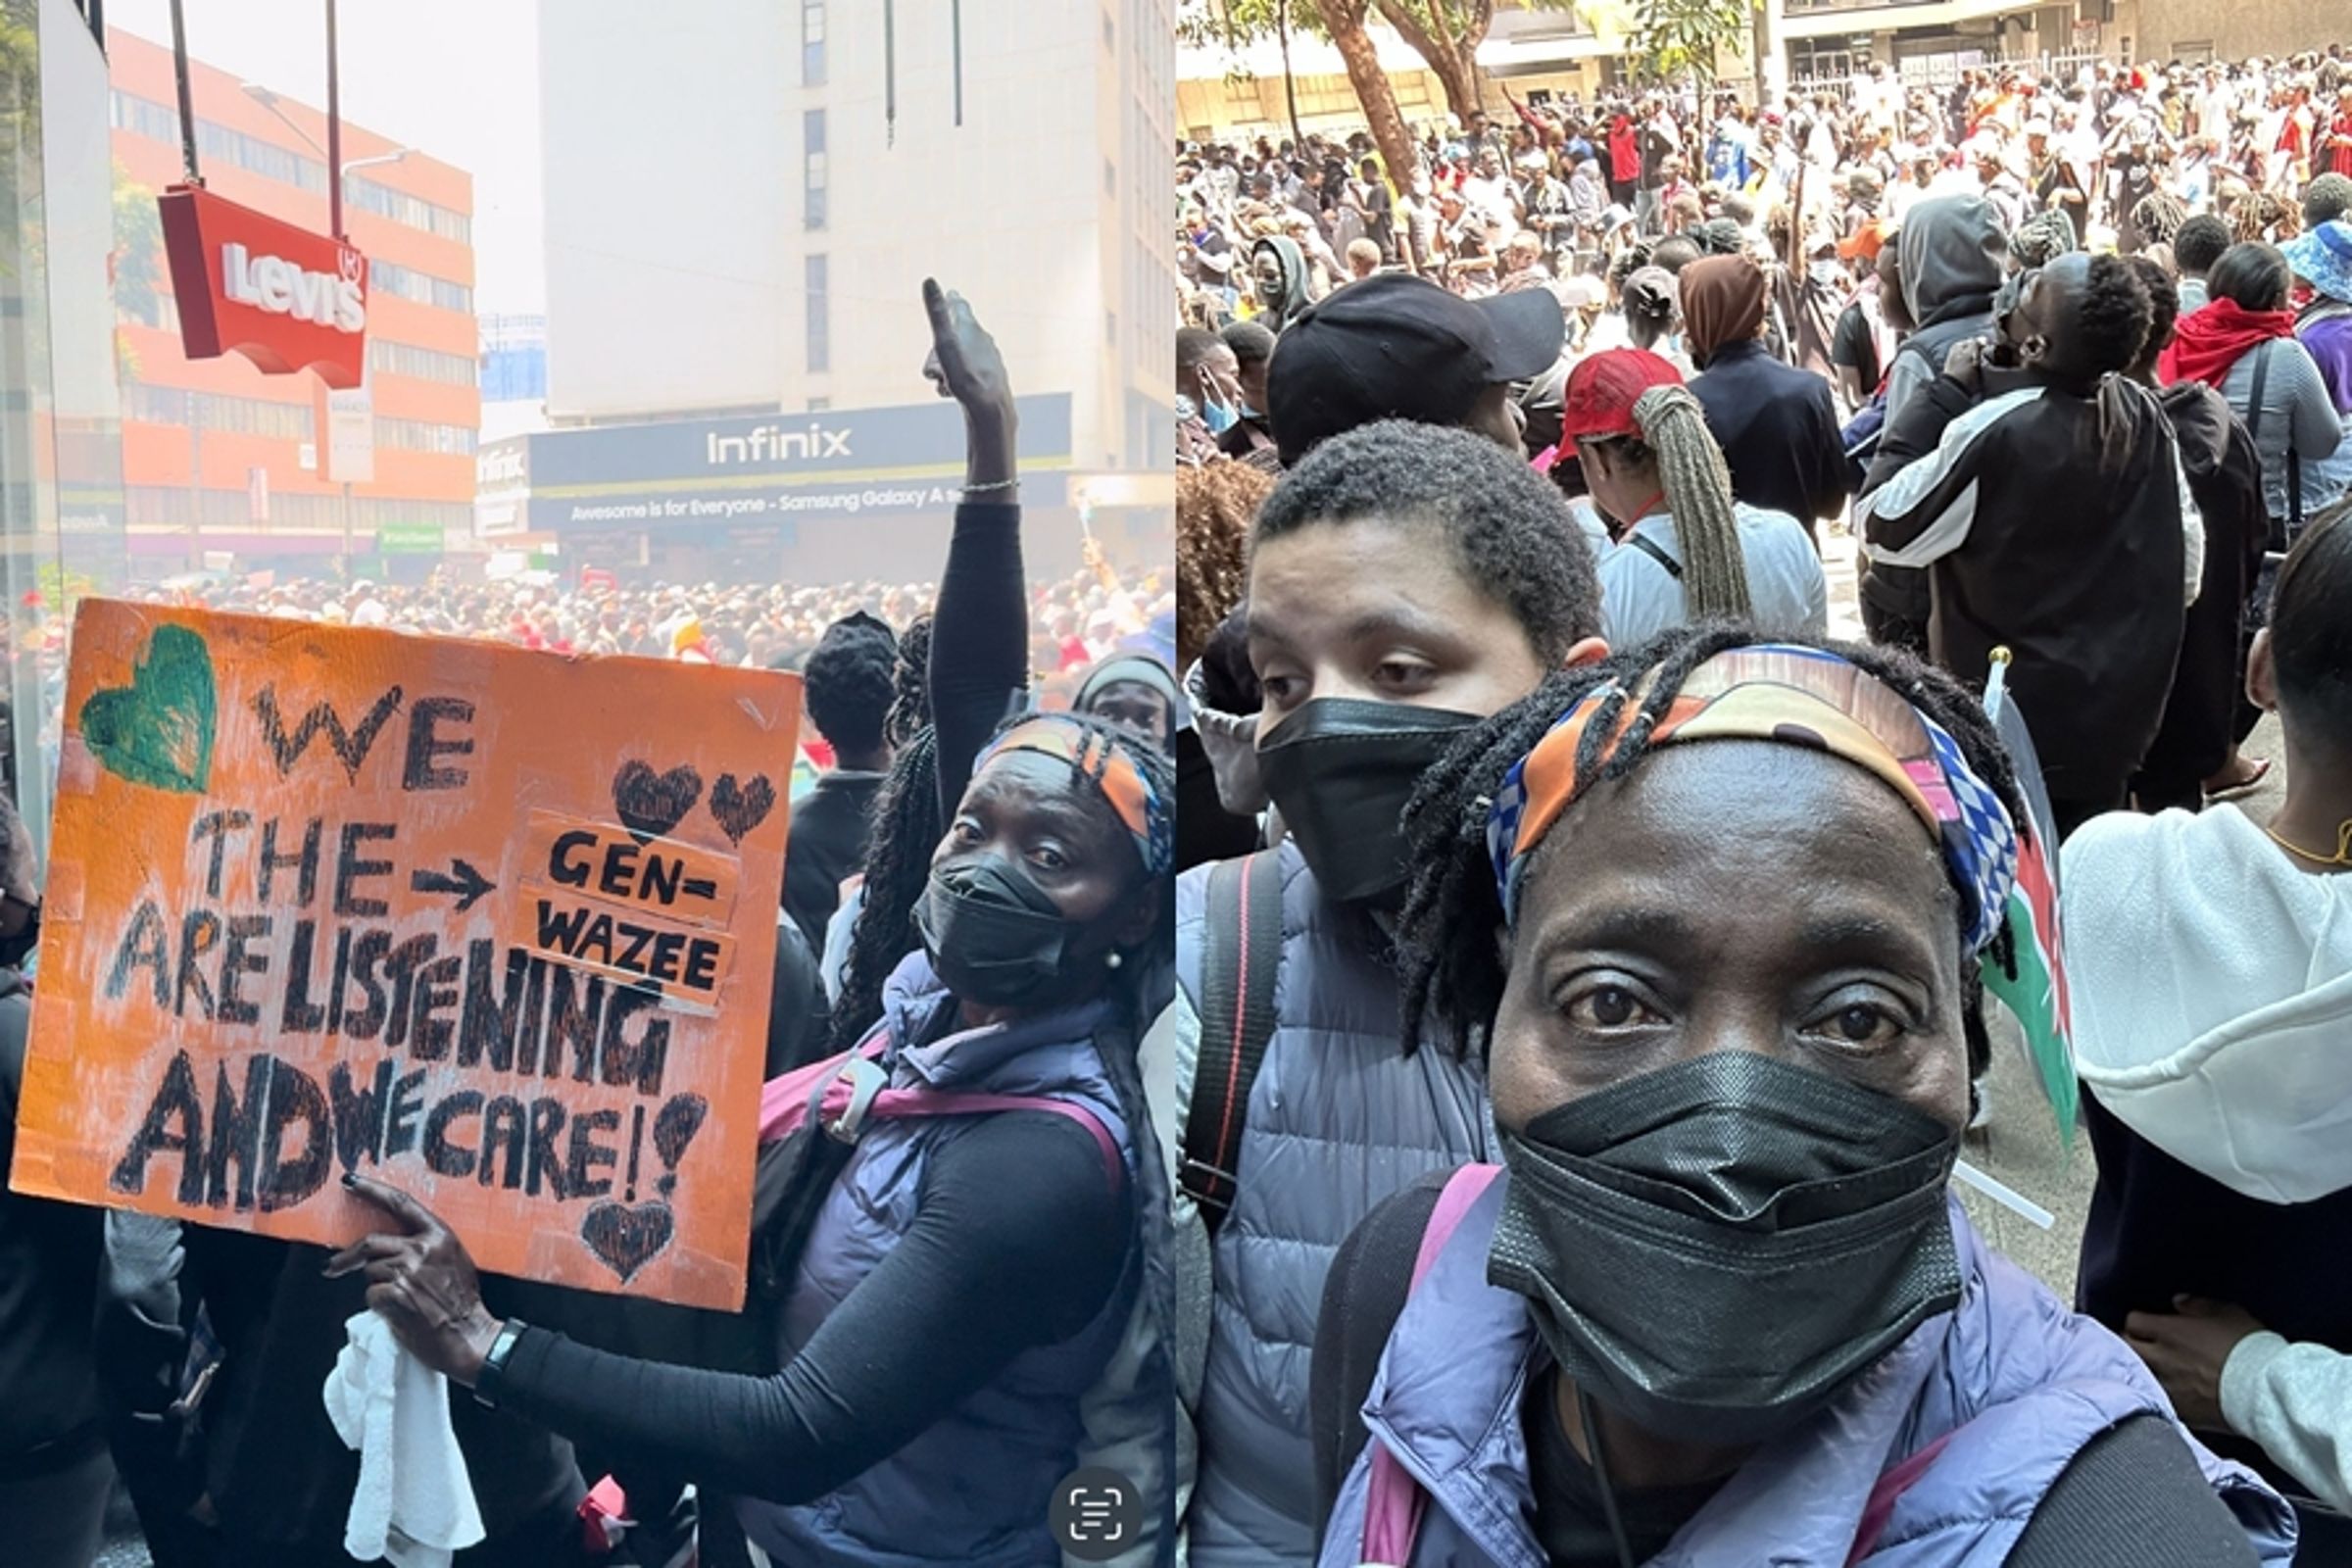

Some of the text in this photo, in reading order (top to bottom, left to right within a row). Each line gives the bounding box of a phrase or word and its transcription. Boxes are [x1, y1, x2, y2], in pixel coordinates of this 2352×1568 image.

[707, 422, 853, 465] Infinix
[571, 505, 647, 521] Awesome
[649, 500, 662, 517] is
[665, 499, 688, 516] for
[690, 496, 766, 519] Everyone
[779, 491, 861, 514] Samsung
[861, 488, 927, 509] Galaxy
[929, 486, 945, 503] A
[249, 683, 476, 792] WE
[191, 809, 397, 918] THE
[548, 830, 717, 906] GEN-
[536, 900, 720, 990] WAZEE
[104, 900, 670, 1097] ARE LISTENING
[109, 1048, 333, 1213] AND
[328, 1057, 427, 1174] WE
